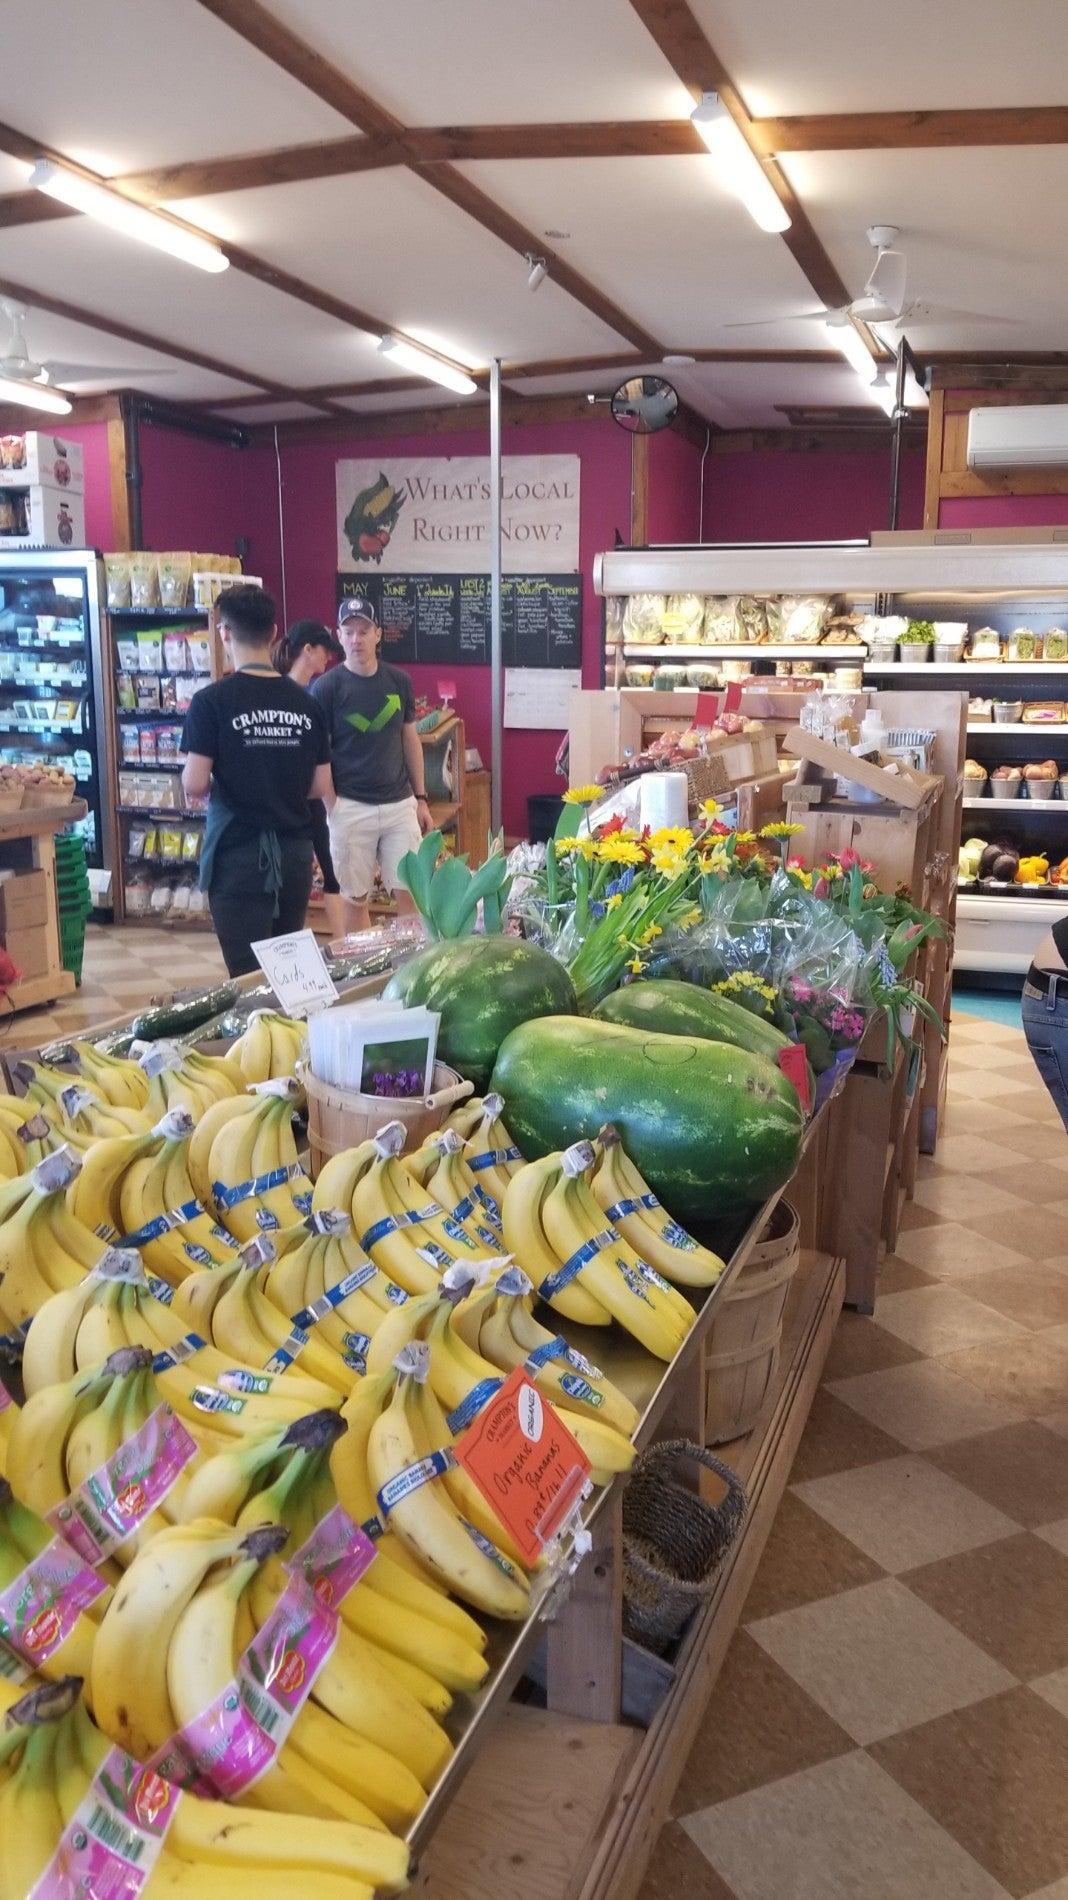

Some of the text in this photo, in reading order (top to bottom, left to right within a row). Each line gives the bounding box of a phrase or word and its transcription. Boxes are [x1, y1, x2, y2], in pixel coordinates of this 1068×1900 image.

[405, 476, 574, 500] WHAT'S LOCAL
[413, 517, 486, 541] RIGHT
[343, 582, 369, 596] MAY
[383, 582, 407, 597] JUNE
[232, 709, 312, 731] CRAMPTON'S
[253, 726, 293, 737] MARKET
[486, 1401, 517, 1443] CRAMPTON'S
[528, 1389, 536, 1437] ORGANIC
[494, 1442, 532, 1495] Organic
[525, 1439, 560, 1490] Bananas
